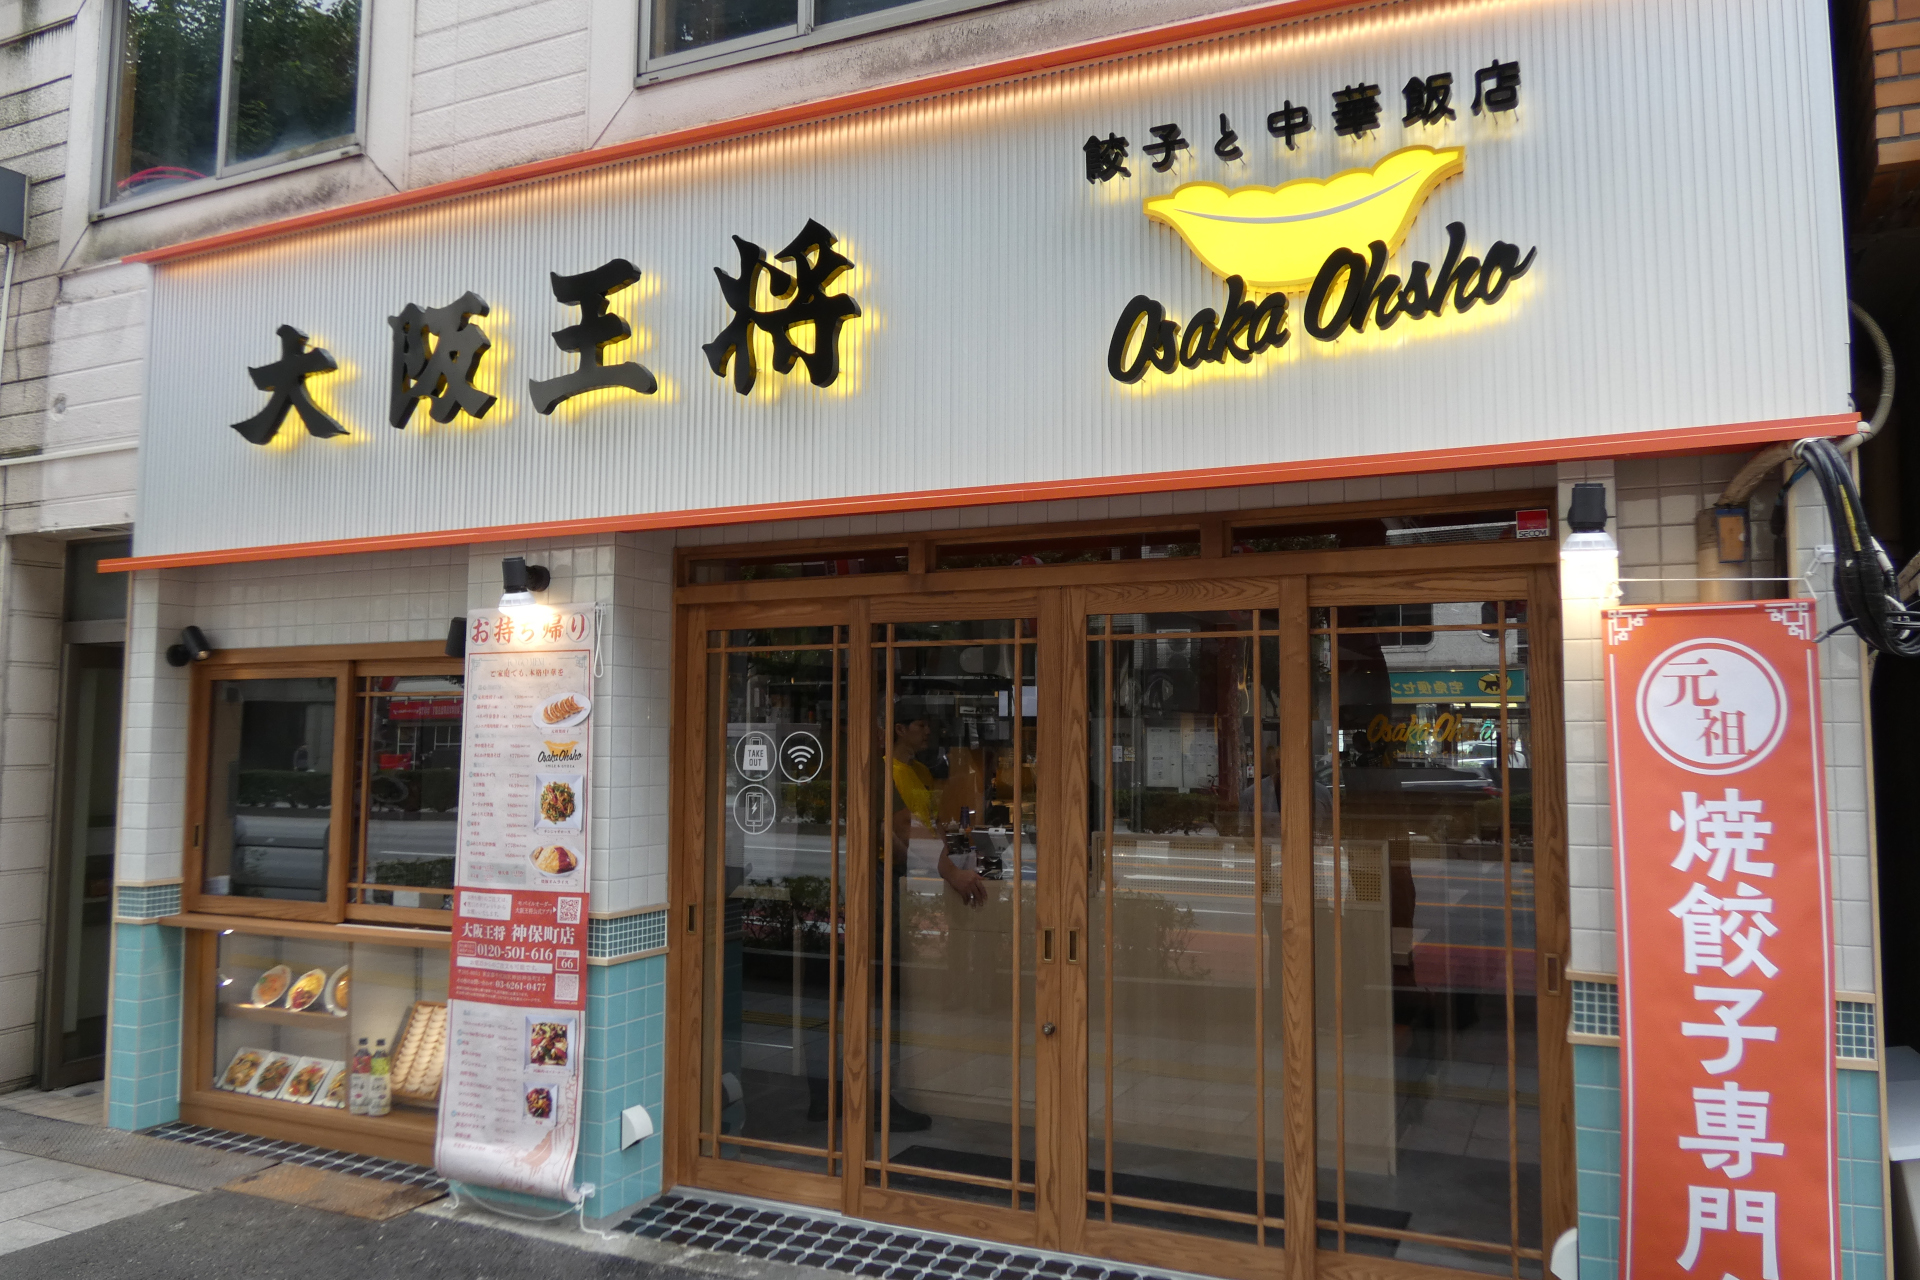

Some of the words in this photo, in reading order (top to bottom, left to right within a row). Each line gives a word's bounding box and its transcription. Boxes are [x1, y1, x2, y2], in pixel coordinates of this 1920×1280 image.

[1083, 59, 1521, 184] 餃子と中華飯店
[1108, 275, 1290, 385] Osaka
[1304, 221, 1537, 342] Ohsho
[230, 218, 861, 445] 大阪王将
[1518, 529, 1547, 538] SECOM
[472, 614, 585, 643] お持ち帰り
[1661, 656, 1750, 757] 元祖
[1366, 713, 1432, 744] Osaka
[537, 750, 558, 762] Osaka
[559, 749, 583, 762] Ohsho
[748, 749, 764, 758] TAKE
[748, 758, 762, 767] OUT
[462, 922, 506, 941] 大阪王将
[511, 924, 575, 945] 神保町店
[477, 944, 553, 961] 0120-501-616
[560, 958, 574, 969] 66
[1668, 787, 1786, 1280] 焼餃子専門
